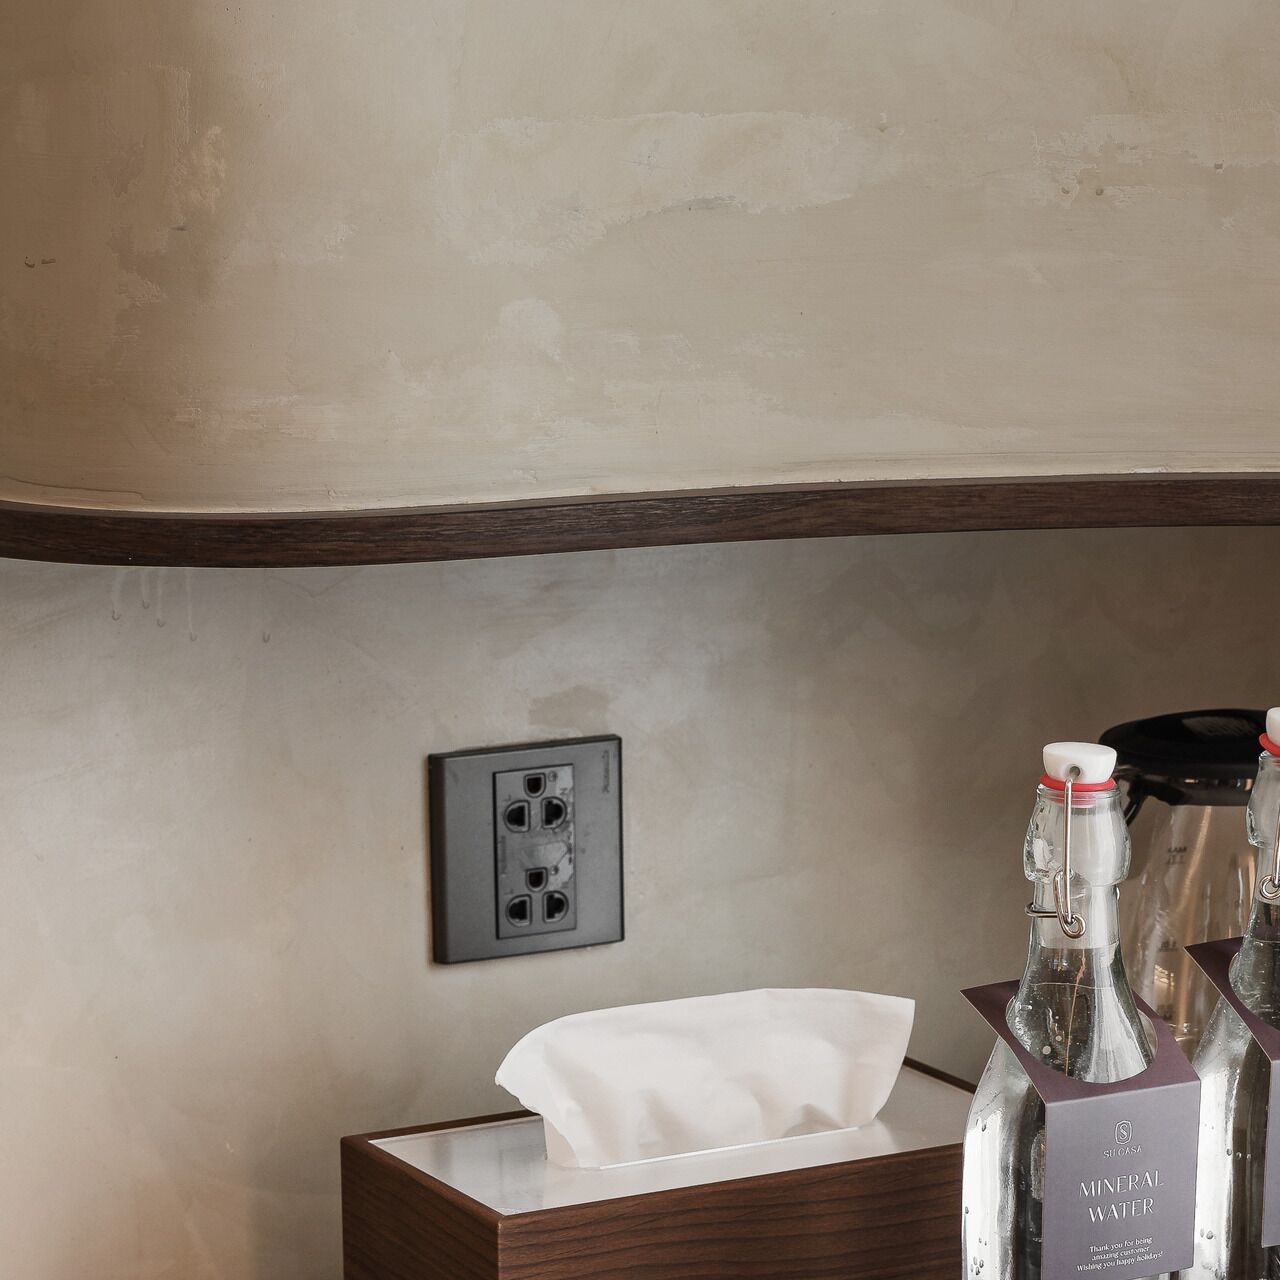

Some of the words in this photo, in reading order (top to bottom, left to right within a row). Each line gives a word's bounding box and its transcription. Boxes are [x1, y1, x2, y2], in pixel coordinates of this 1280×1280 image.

[1080, 1170, 1165, 1197] MINERAL
[1088, 1197, 1154, 1223] WATER
[1089, 1243, 1109, 1253] Thank
[1110, 1242, 1123, 1251] you
[1124, 1239, 1134, 1247] for
[1135, 1237, 1153, 1245] being
[1091, 1252, 1119, 1261] amazing
[1120, 1246, 1150, 1256] customer
[1076, 1262, 1102, 1272] Wishing
[1102, 1260, 1116, 1269] you
[1116, 1257, 1135, 1266] happy
